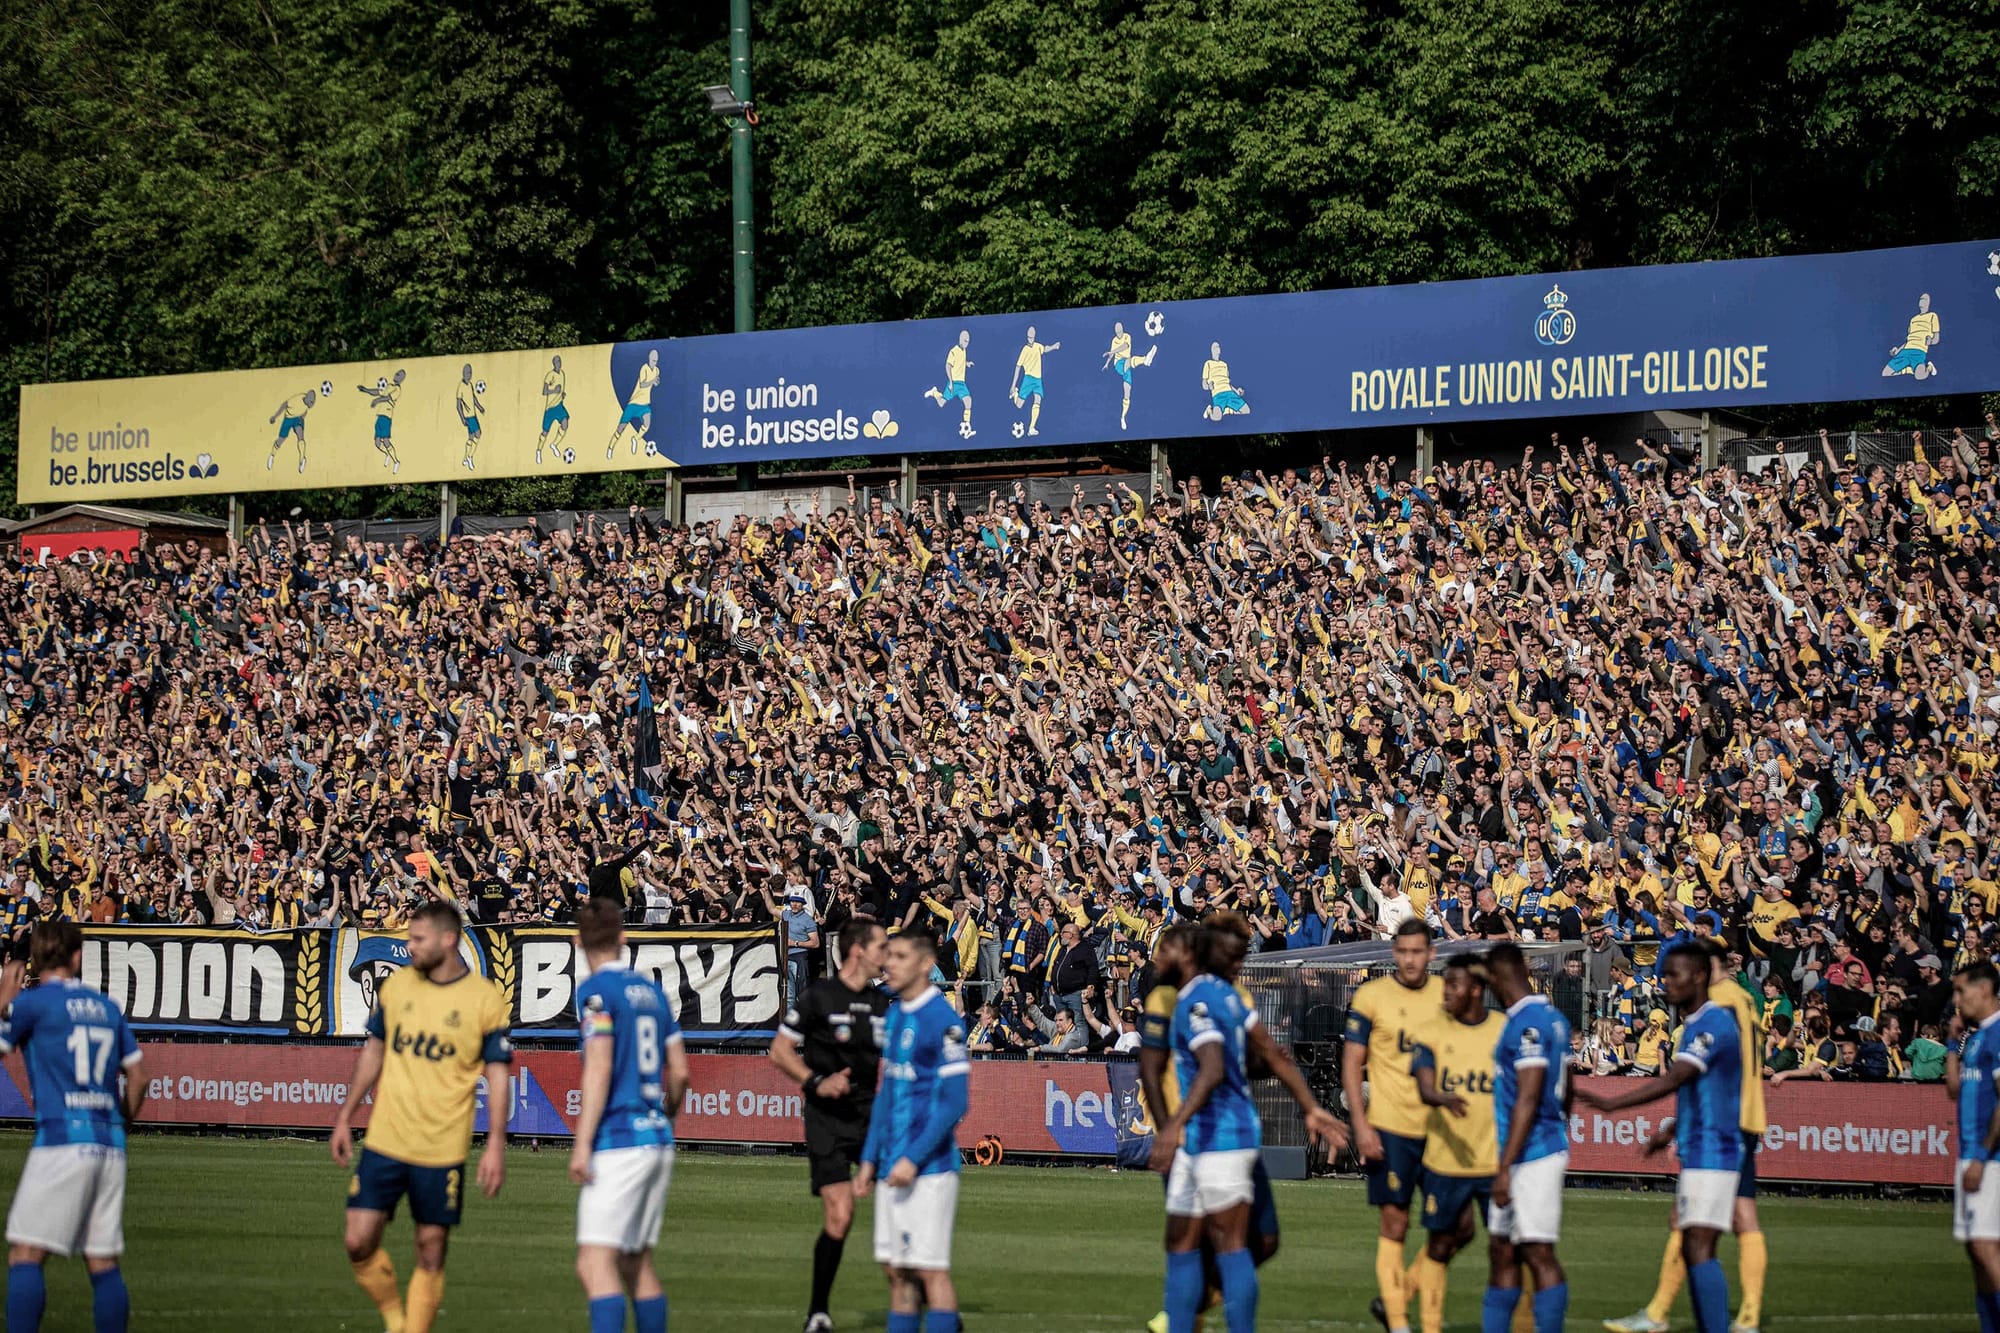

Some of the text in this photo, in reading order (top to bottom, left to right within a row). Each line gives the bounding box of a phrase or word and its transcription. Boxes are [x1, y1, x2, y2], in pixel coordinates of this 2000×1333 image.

[703, 377, 818, 413] be union
[1350, 344, 1769, 413] ROYALE UNION SAINT-GILLOISE
[50, 421, 150, 453] be union
[702, 409, 859, 449] be.brussels
[49, 452, 185, 486] be.brussels
[81, 940, 780, 1023] NION BOYS
[66, 1025, 115, 1086] 17
[391, 1023, 457, 1063] lotto
[636, 1015, 660, 1075] 8
[144, 1076, 174, 1101] et
[178, 1076, 373, 1106] Orange-netwe
[685, 1088, 731, 1116] het
[736, 1090, 806, 1121] Oran
[1593, 1114, 1650, 1144] het
[1756, 1122, 1949, 1155] e-netwerk
